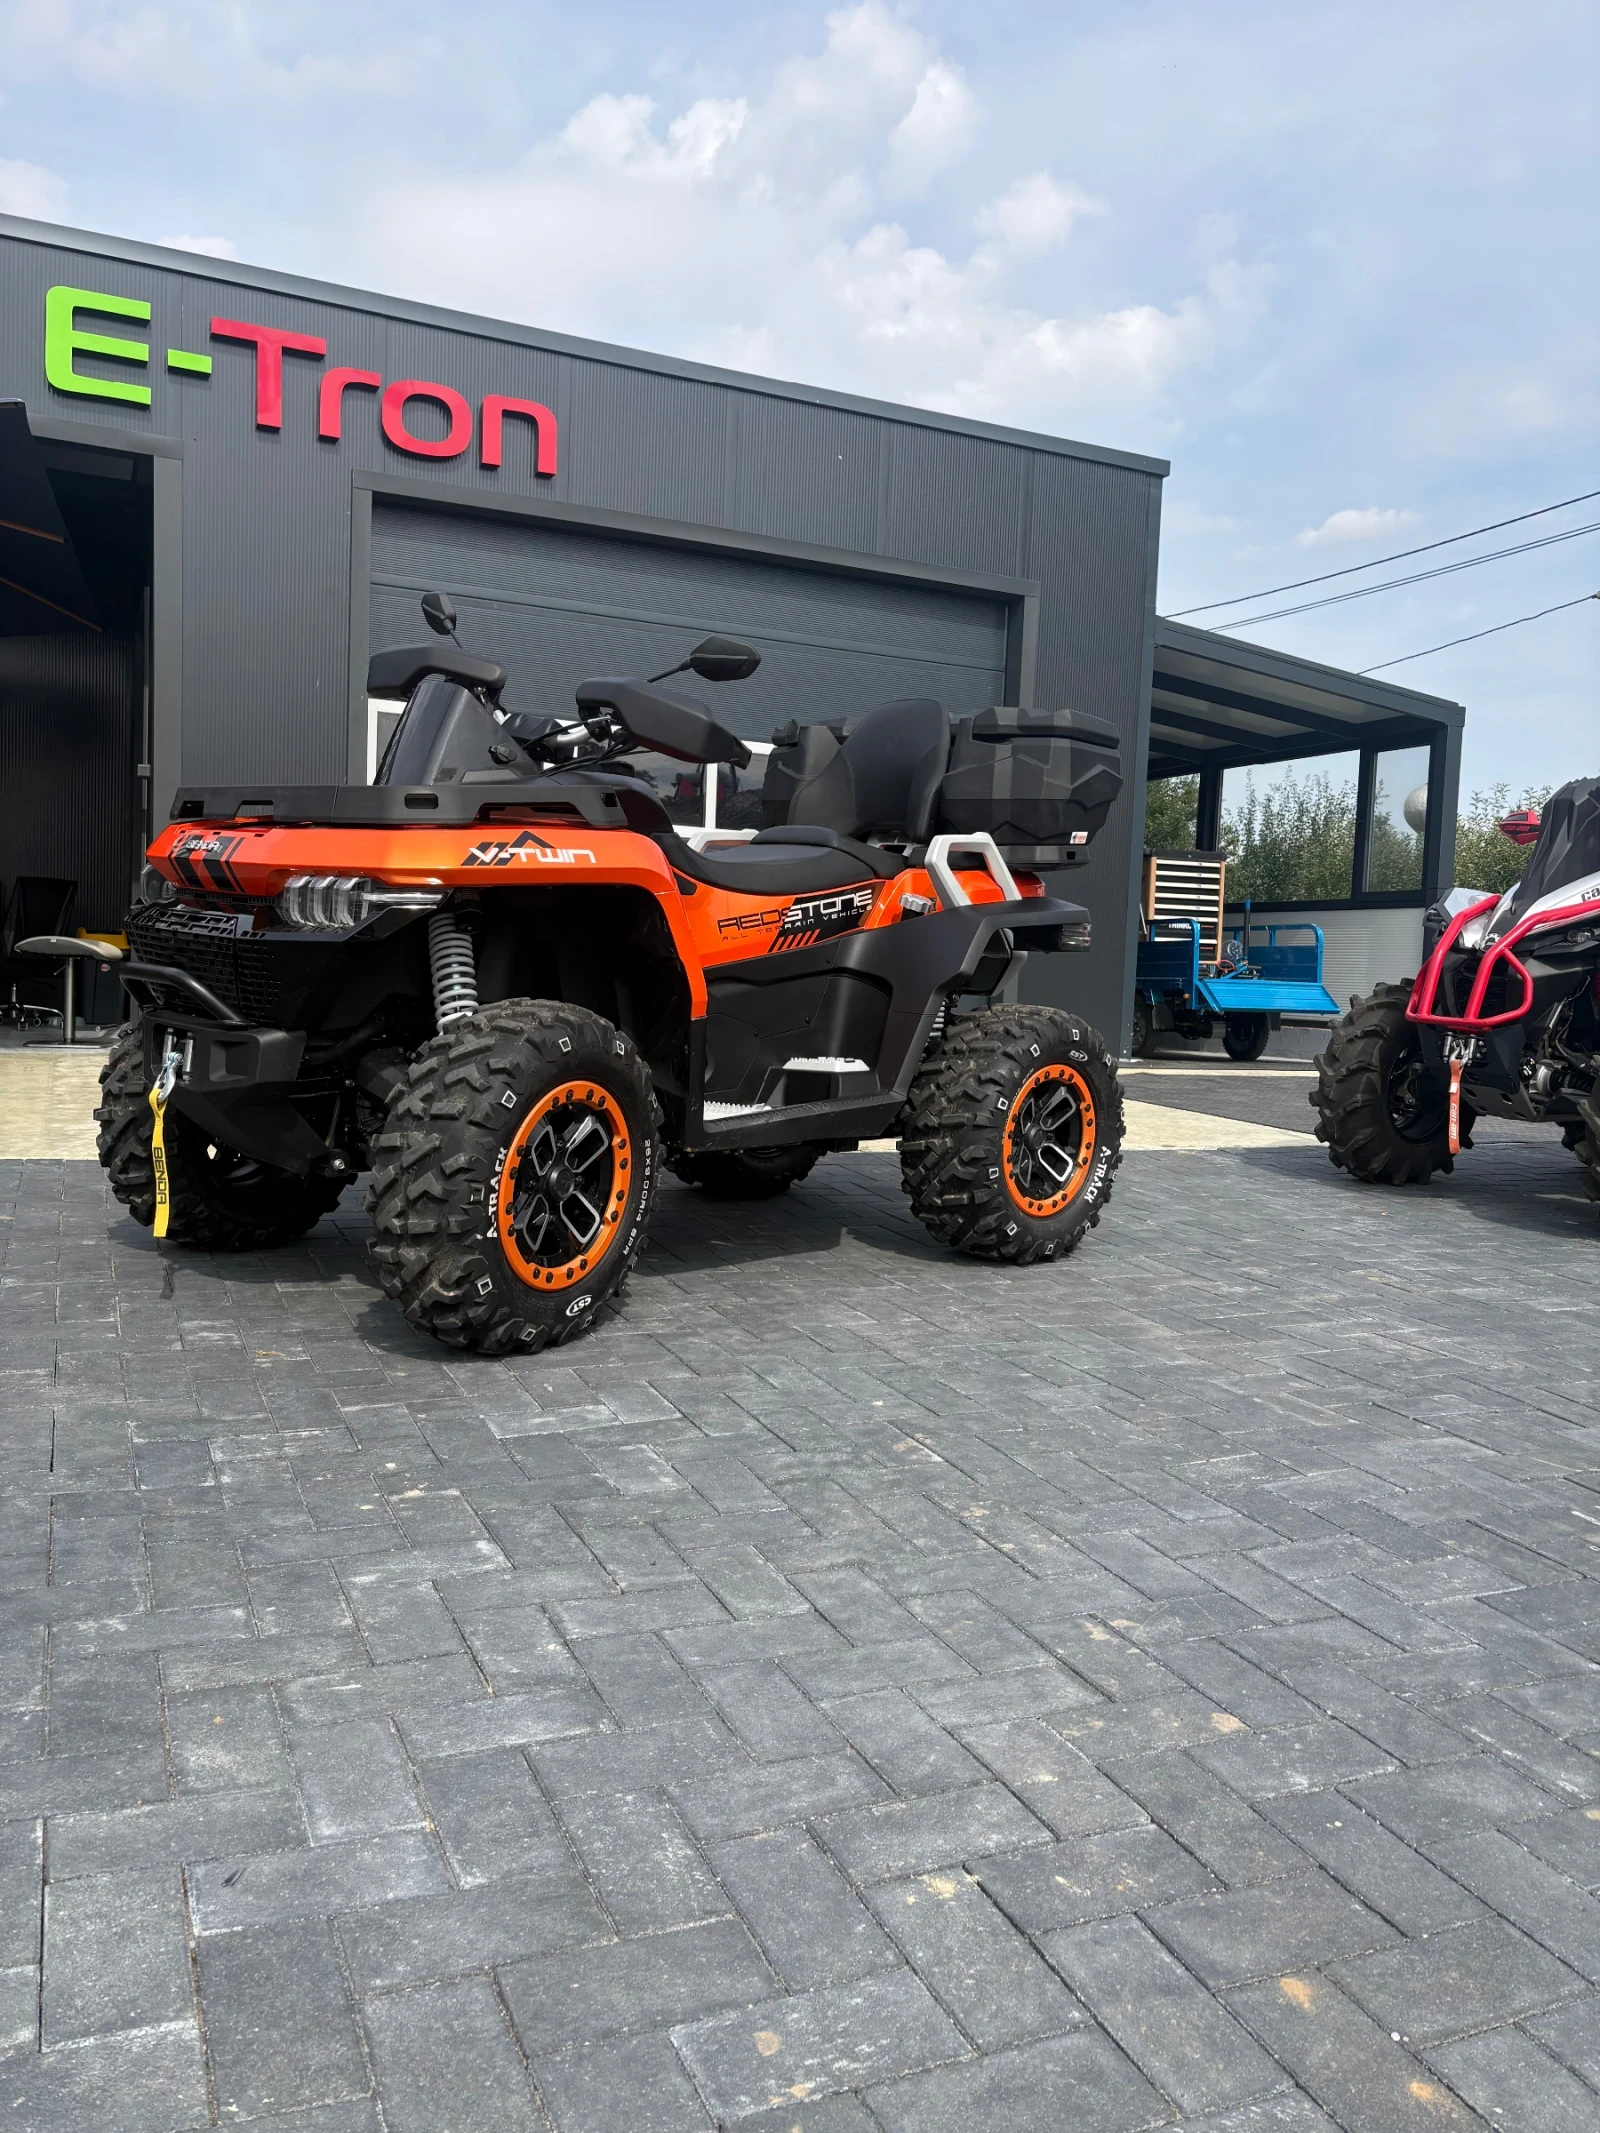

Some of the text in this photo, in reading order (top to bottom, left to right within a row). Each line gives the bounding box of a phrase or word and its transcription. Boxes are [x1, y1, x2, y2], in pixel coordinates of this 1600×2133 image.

[45, 285, 558, 478] E-Tron
[468, 847, 597, 864] V-TWIN
[716, 889, 873, 935] REDSTONE
[721, 904, 873, 942] ALL TERRAIN VEHICLE
[153, 1146, 167, 1205] BENDA
[486, 1146, 508, 1238] A-TRACK
[1084, 1145, 1112, 1204] A-TRACK
[571, 1296, 592, 1314] CST
